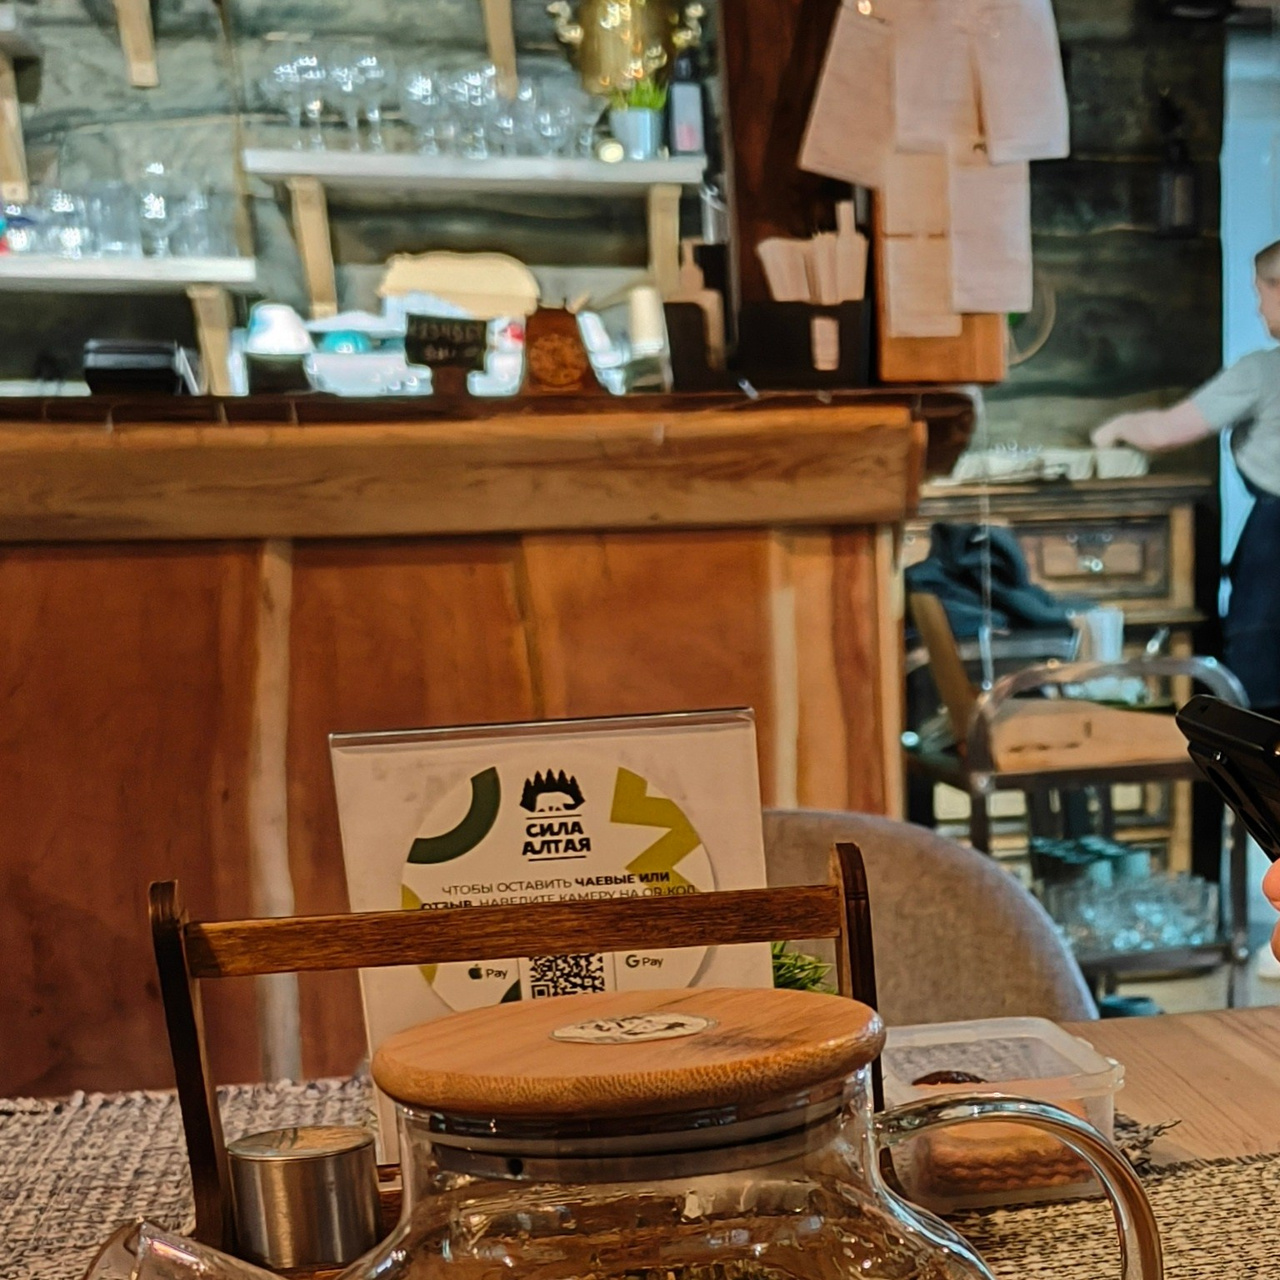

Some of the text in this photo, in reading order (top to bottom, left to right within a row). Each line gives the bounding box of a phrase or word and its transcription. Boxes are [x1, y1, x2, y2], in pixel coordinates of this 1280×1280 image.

[525, 821, 584, 838] СИЛА
[521, 837, 592, 856] АЛТАЯ
[442, 871, 671, 896] ЧТОБЫ ОСТАВИТЬ ЧАЕВЫЕ ИЛИ
[642, 957, 664, 968] Pay
[486, 968, 509, 980] Pay
